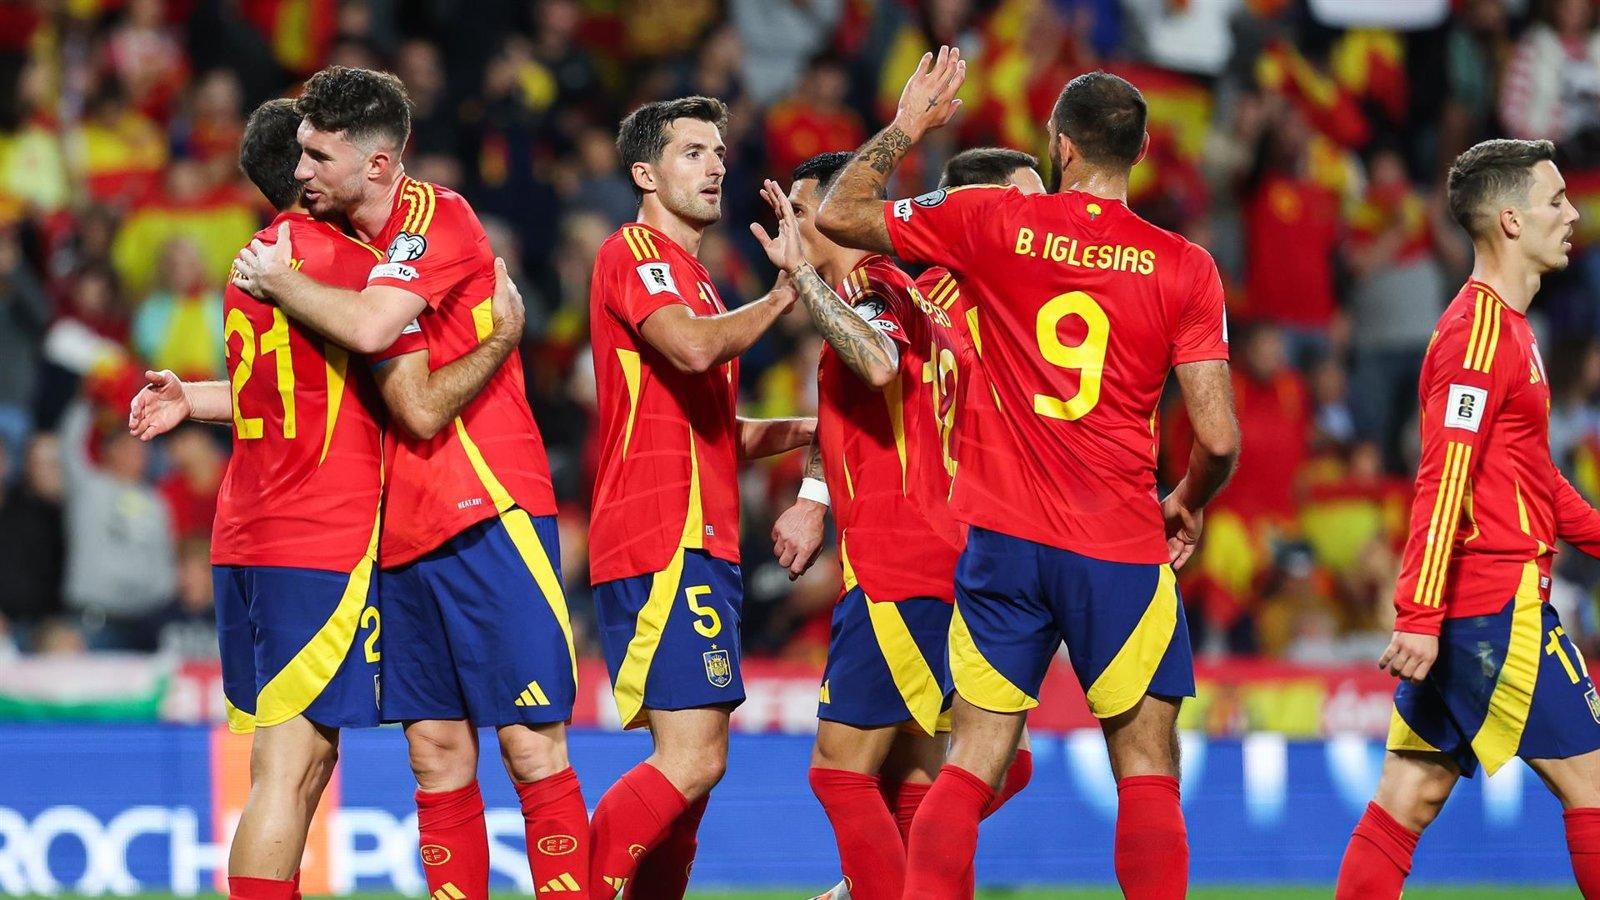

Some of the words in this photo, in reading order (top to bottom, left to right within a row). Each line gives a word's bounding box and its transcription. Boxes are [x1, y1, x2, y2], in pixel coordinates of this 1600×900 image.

[1015, 227, 1037, 257] B.
[1043, 232, 1156, 275] IGLESIAS
[224, 306, 296, 440] 21
[1034, 290, 1110, 421] 9
[685, 585, 722, 638] 5
